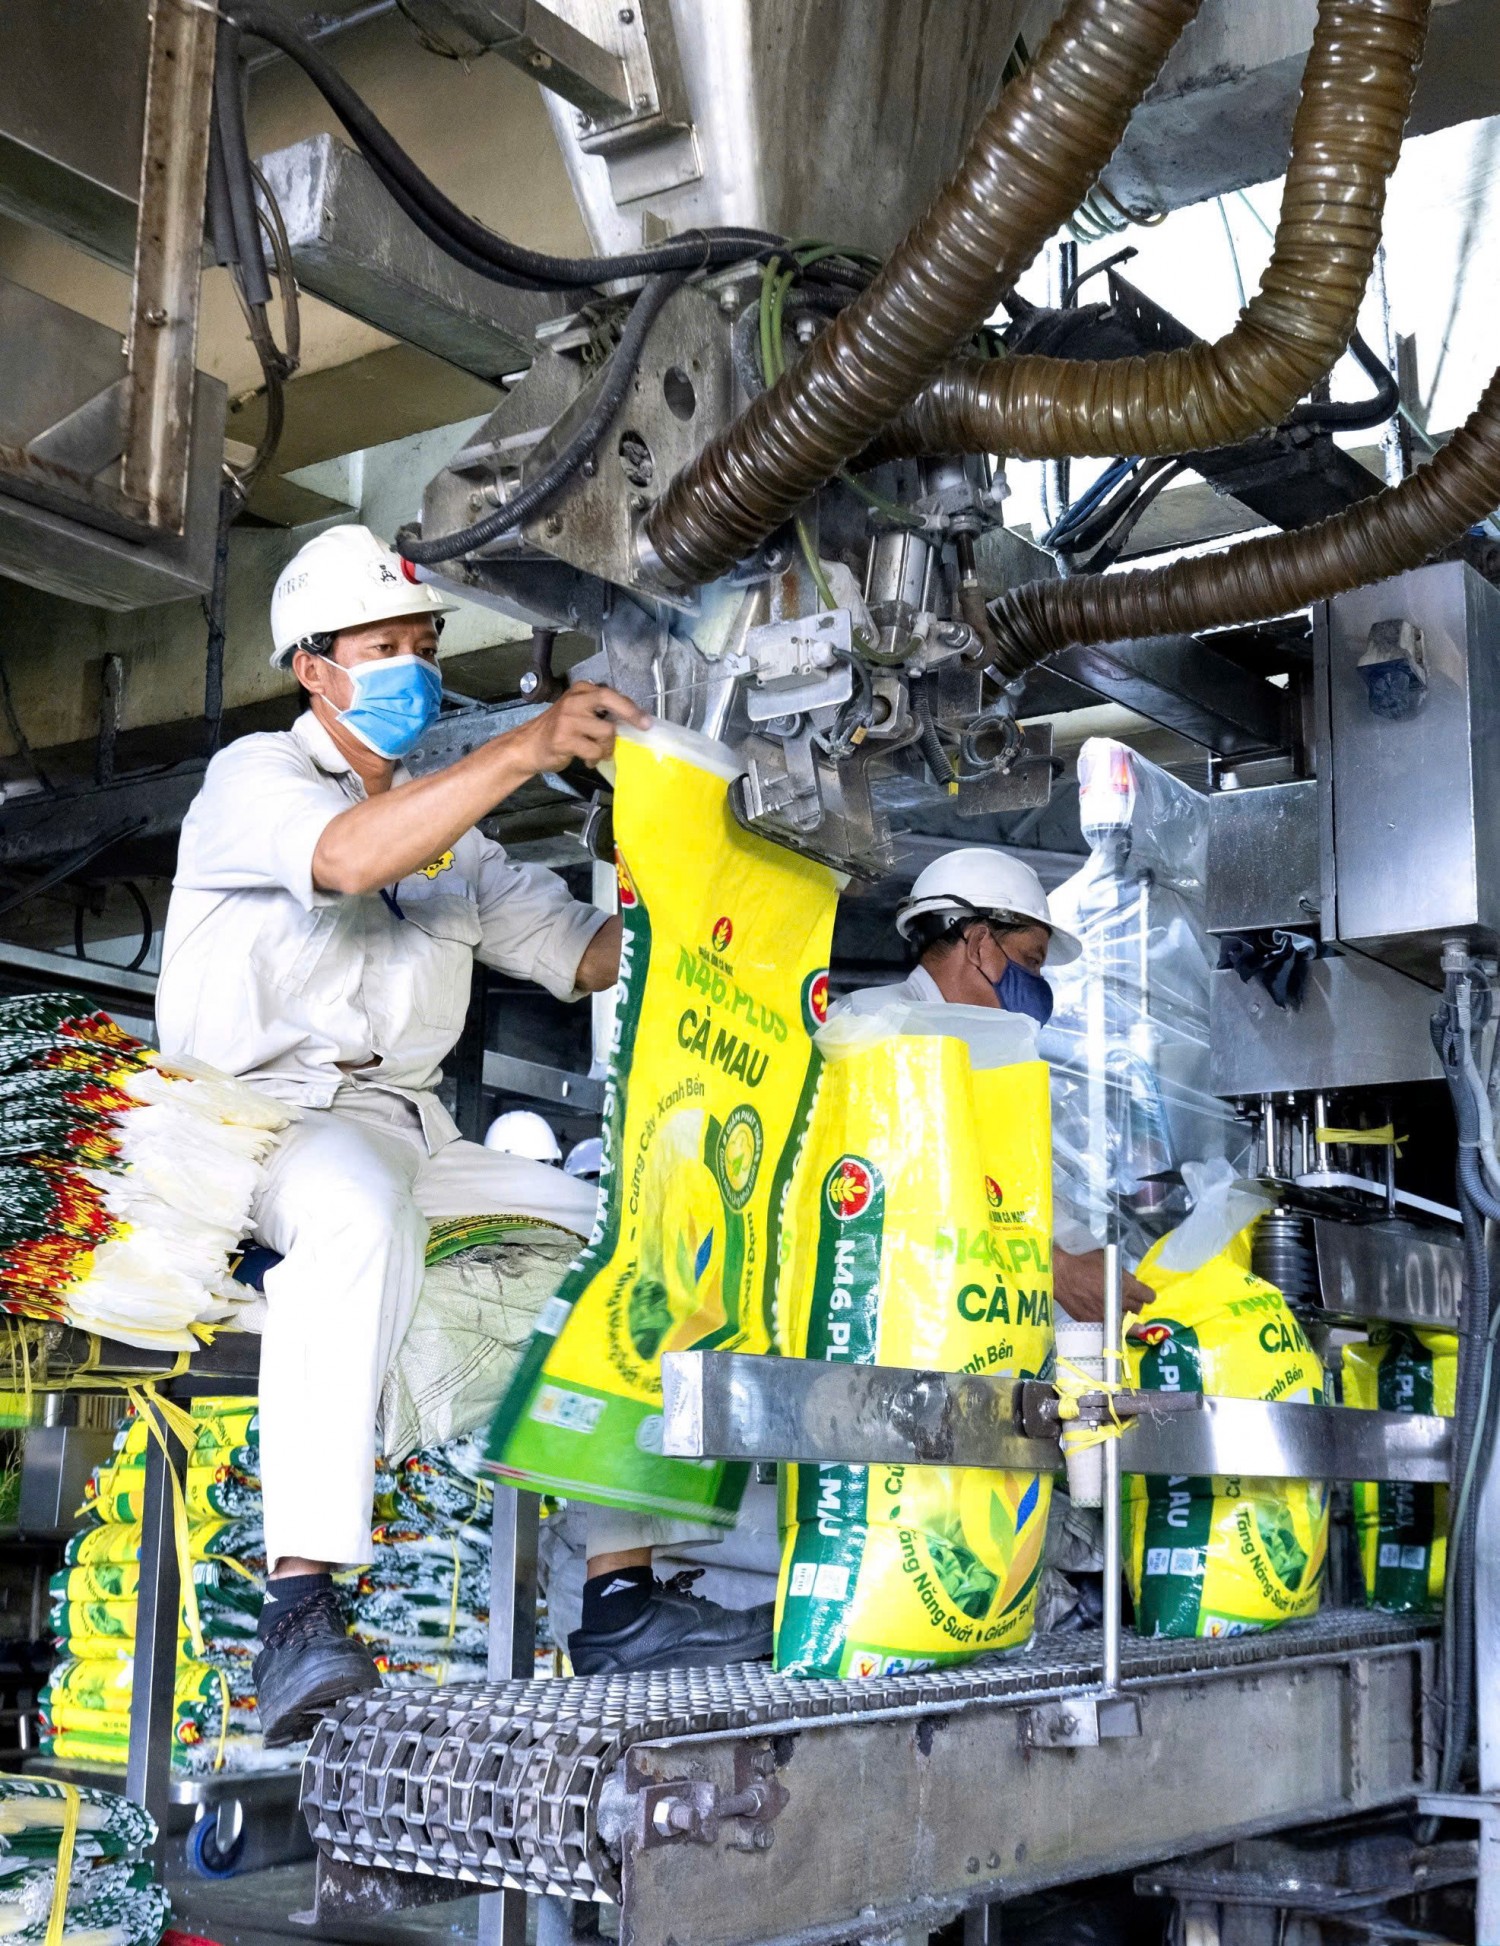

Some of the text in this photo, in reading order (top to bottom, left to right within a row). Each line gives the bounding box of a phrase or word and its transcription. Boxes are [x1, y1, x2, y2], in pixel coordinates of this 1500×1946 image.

[678, 1004, 769, 1088] CÀ MAU
[657, 1081, 685, 1118] Xanh
[935, 1226, 1052, 1274] N46.PL
[826, 1239, 855, 1361] N46.PL
[957, 1274, 1050, 1327] CÀ MA
[987, 1338, 1013, 1364] Bền
[1259, 1314, 1294, 1353] CÀ
[1259, 1379, 1287, 1401] anh
[1236, 1508, 1256, 1556] Tăng
[1250, 1554, 1274, 1598] Năng
[897, 1526, 920, 1573] ăng
[913, 1572, 946, 1626] Năng
[943, 1616, 974, 1642] Suất
